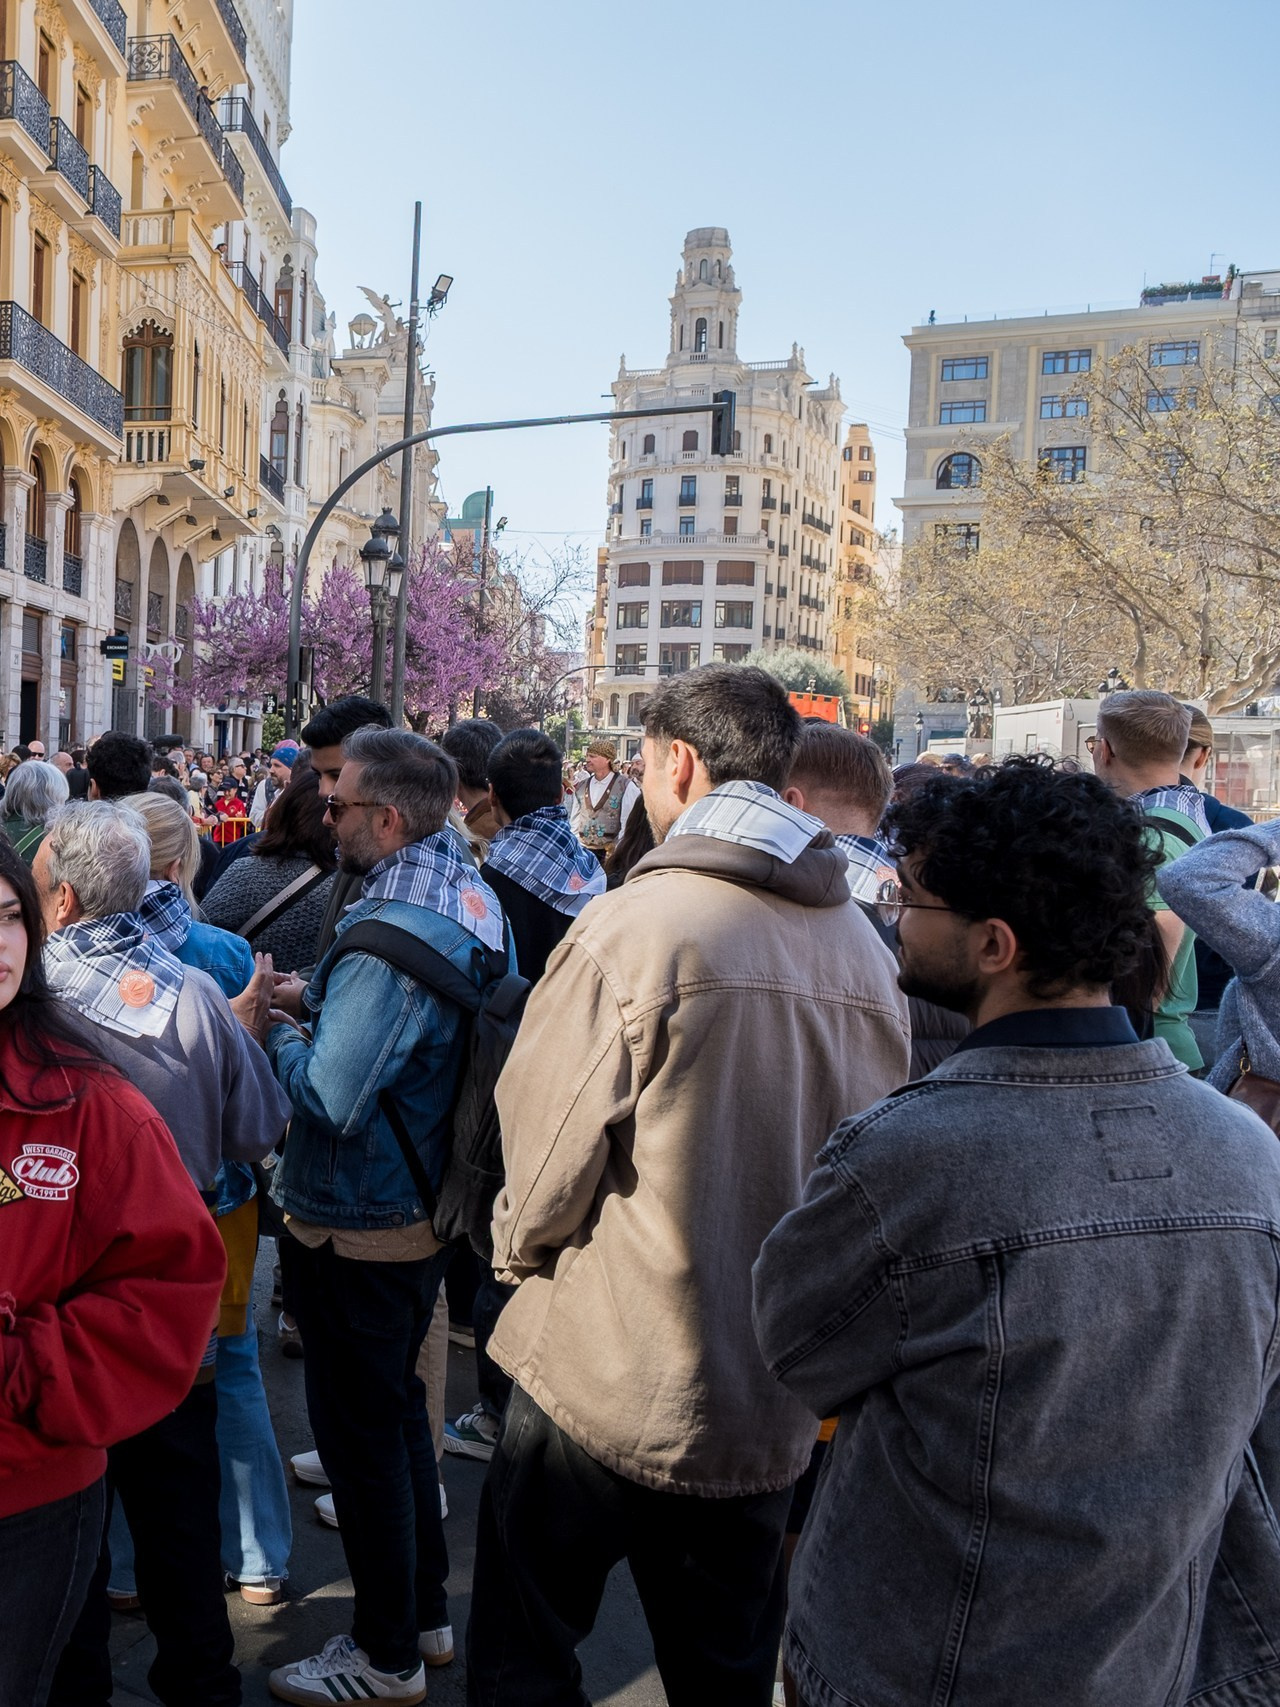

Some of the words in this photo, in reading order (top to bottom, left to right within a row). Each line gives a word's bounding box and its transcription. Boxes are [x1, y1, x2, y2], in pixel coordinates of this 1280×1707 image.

[25, 1146, 45, 1155] WEST
[45, 1147, 73, 1160] GARAGE
[14, 1157, 74, 1185] Club
